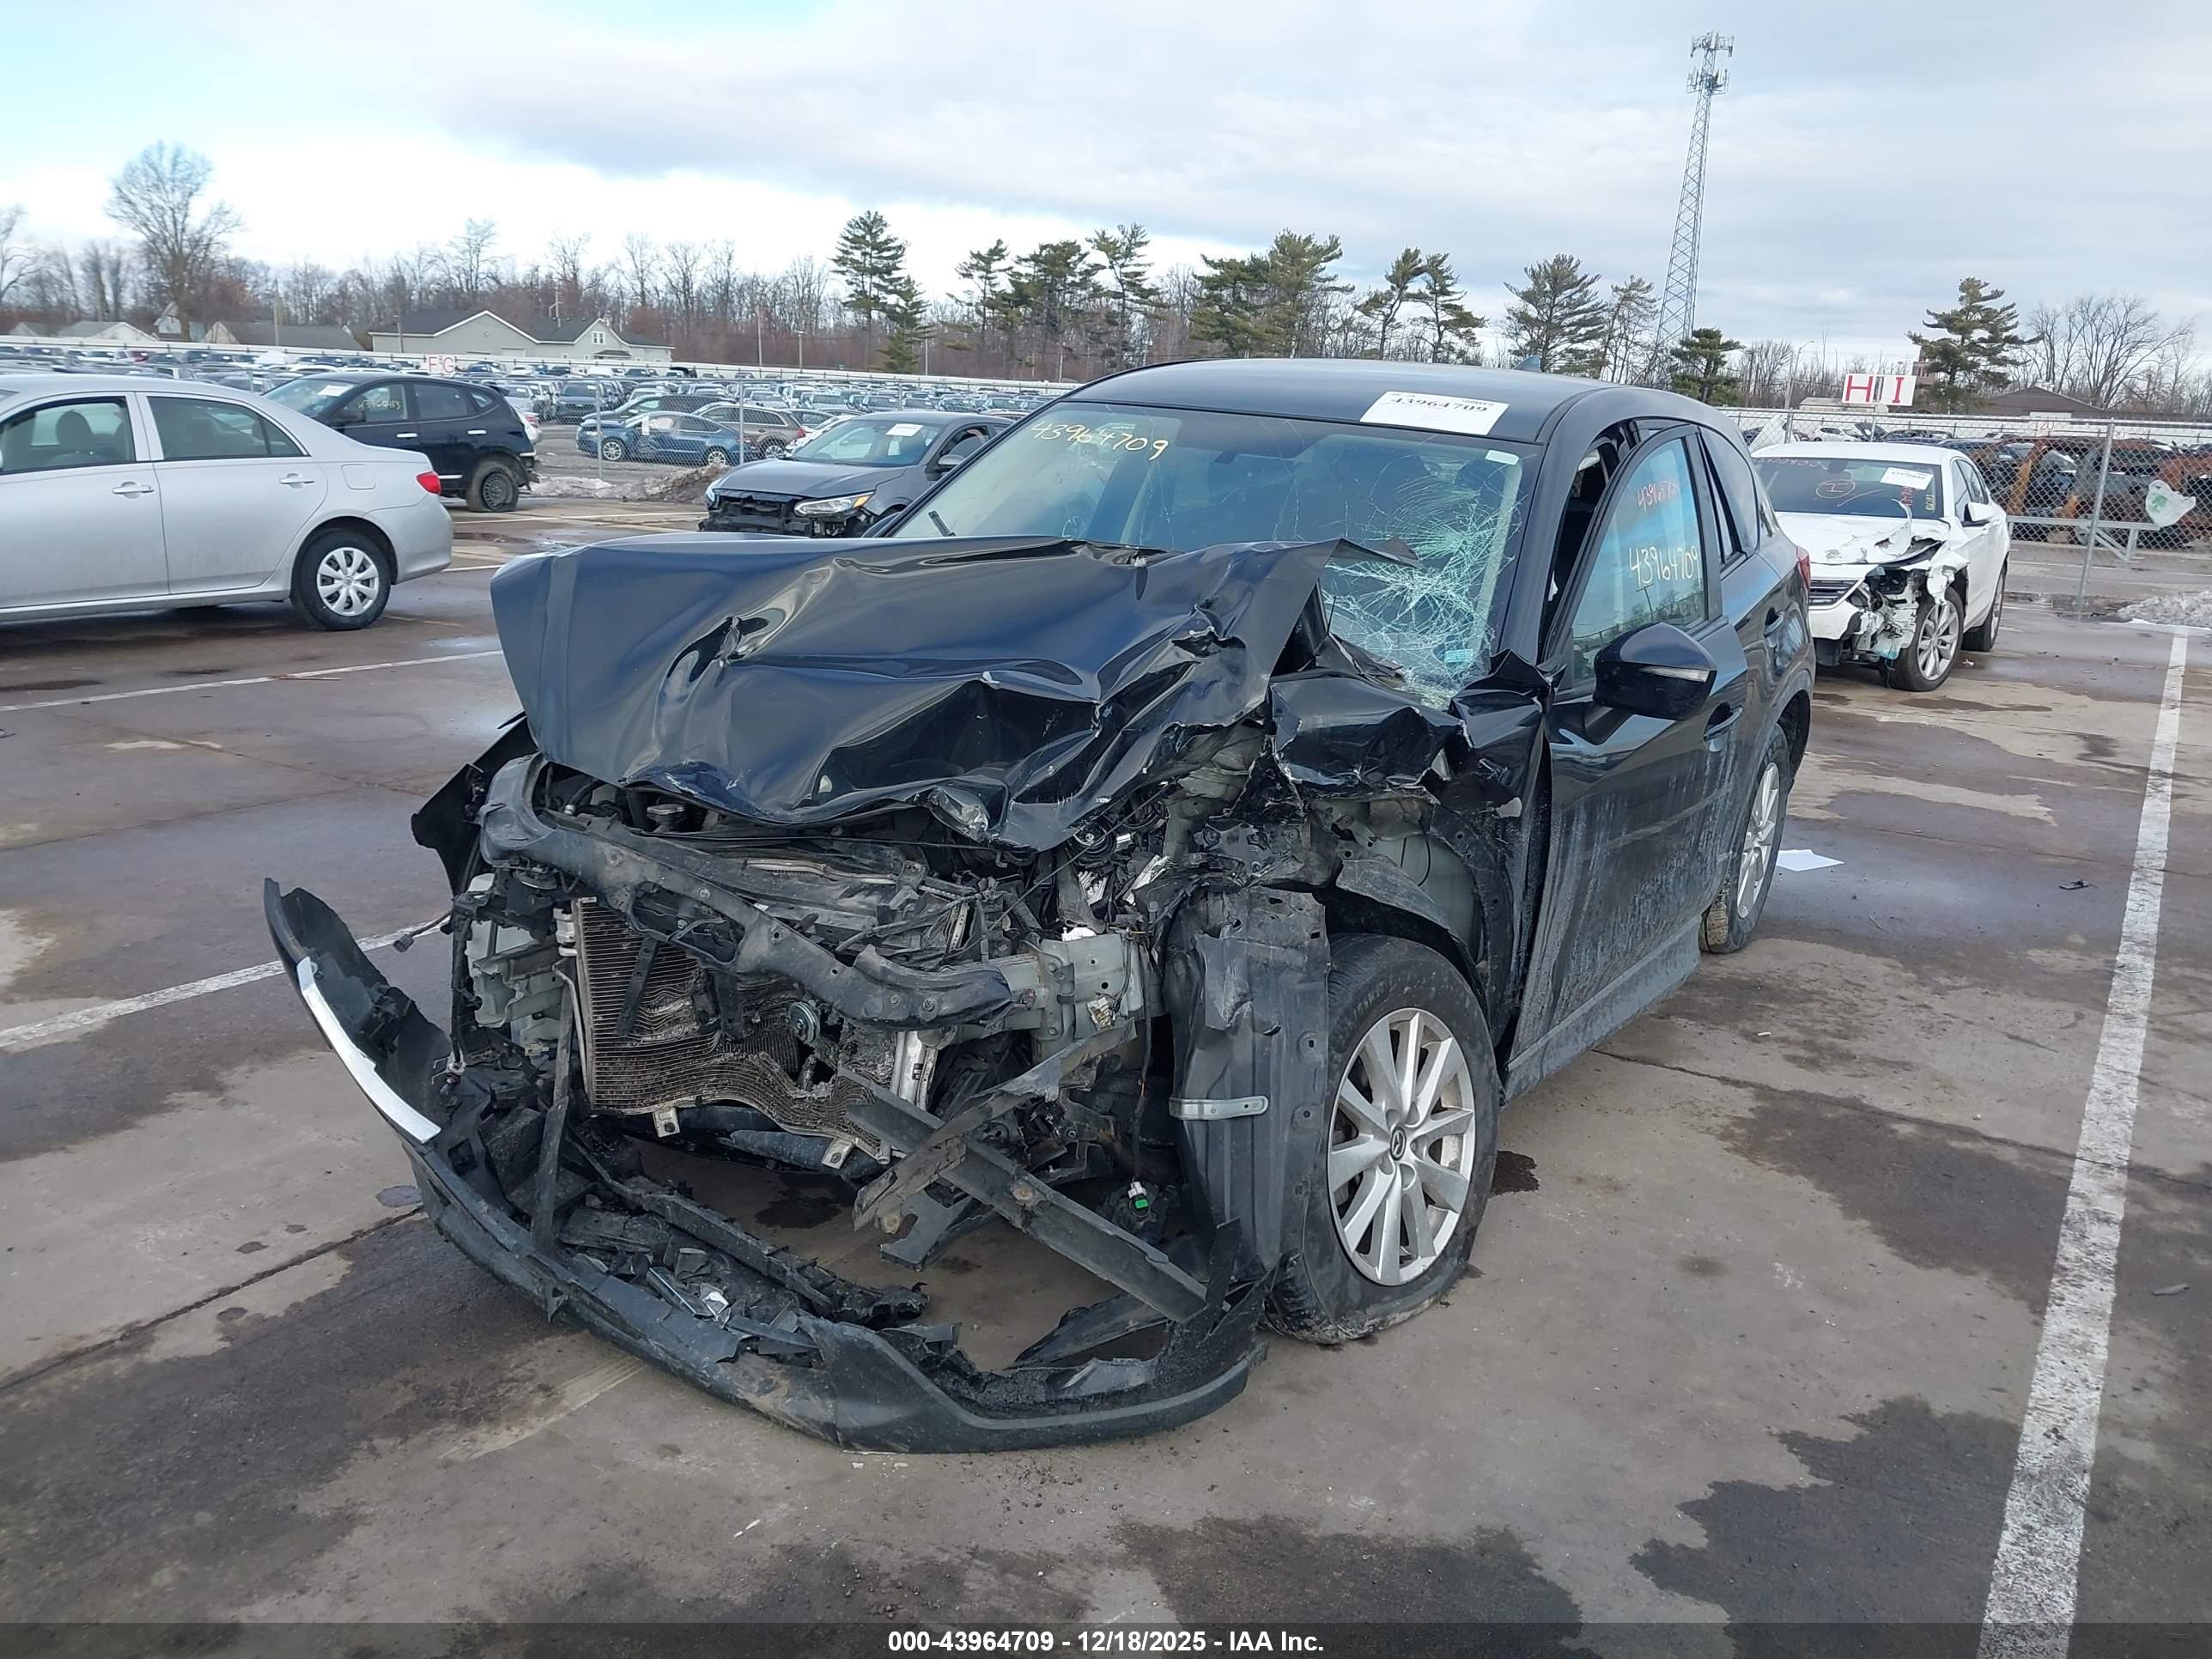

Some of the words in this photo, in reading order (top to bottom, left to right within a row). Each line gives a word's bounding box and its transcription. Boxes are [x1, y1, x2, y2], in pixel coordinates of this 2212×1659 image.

[1390, 397, 1488, 412] 43964709
[1031, 421, 1169, 460] 43964709
[1629, 545, 1701, 589] 43964709
